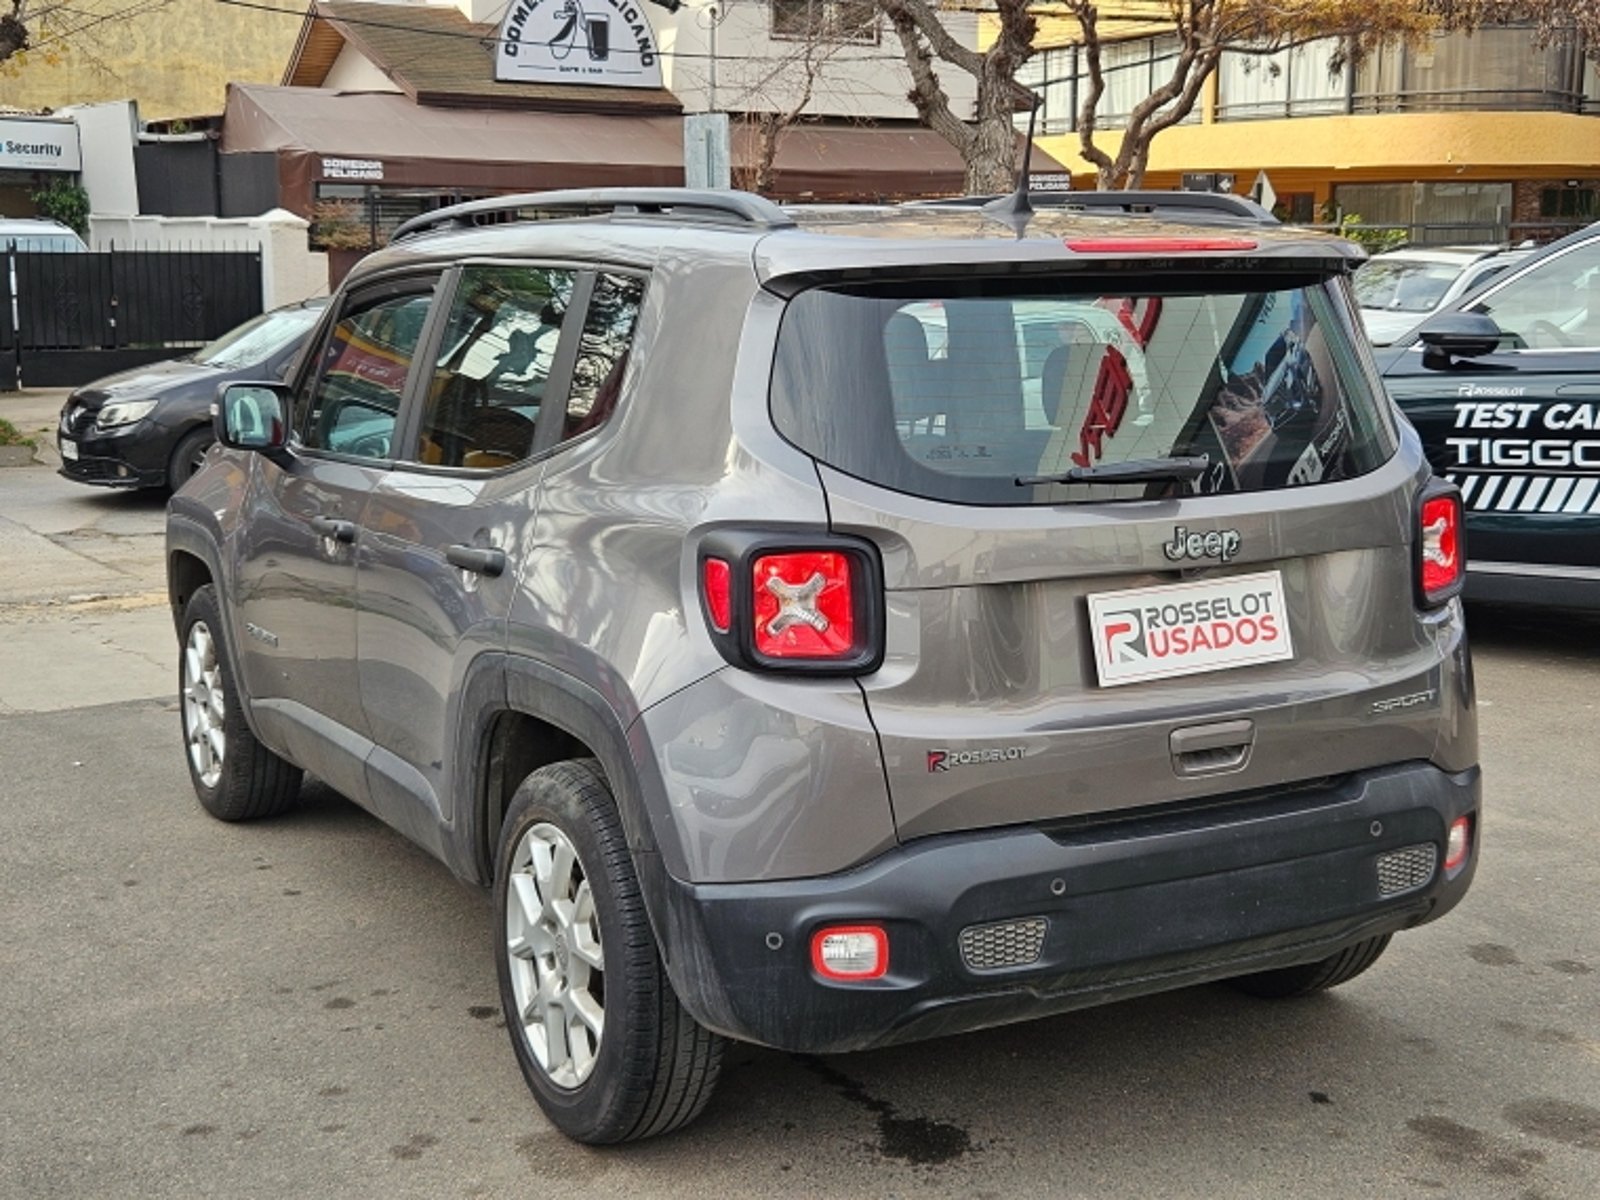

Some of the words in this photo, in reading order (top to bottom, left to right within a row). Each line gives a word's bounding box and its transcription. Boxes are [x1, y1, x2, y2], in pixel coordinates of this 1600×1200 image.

[505, 0, 544, 57] COME
[6, 141, 62, 156] Security
[322, 159, 384, 169] COMEDOR
[322, 168, 384, 179] PELICANO
[1454, 403, 1540, 428] TEST
[1163, 526, 1241, 561] Jeep
[1146, 591, 1272, 628] ROSSELOT
[1149, 614, 1278, 657] USADOS
[949, 747, 1026, 766] ROSSELOT
